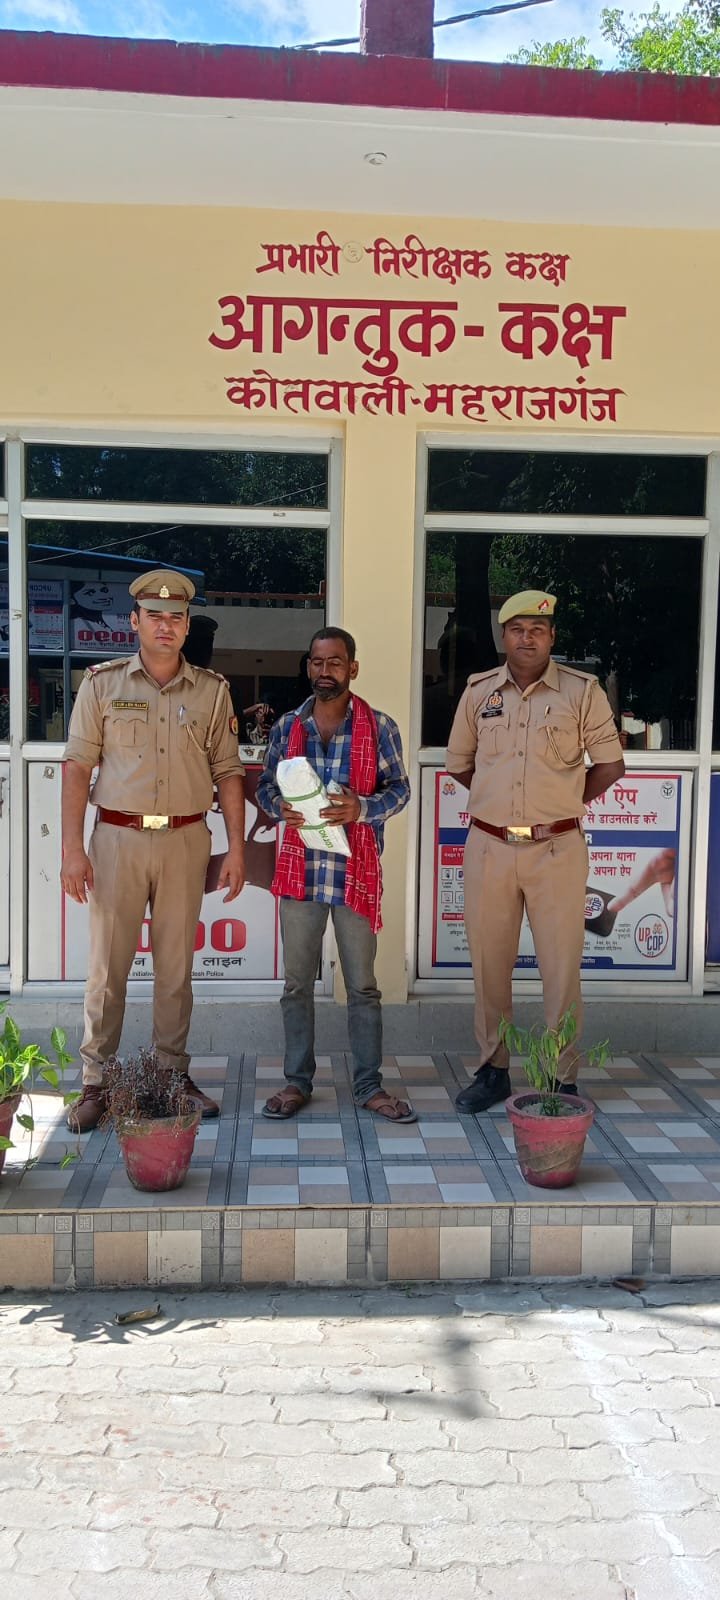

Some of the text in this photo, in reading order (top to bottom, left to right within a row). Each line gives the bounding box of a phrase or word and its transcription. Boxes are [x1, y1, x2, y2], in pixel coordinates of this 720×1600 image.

[256, 230, 570, 287] प्रभारी निरीक्षक कक्ष
[499, 302, 627, 368] कक्ष
[613, 783, 638, 809] ऐप
[599, 811, 640, 825] डाउनलोड
[590, 852, 613, 861] अपना
[593, 866, 617, 876] अपना
[639, 927, 651, 943] UP
[646, 935, 664, 951] COP
